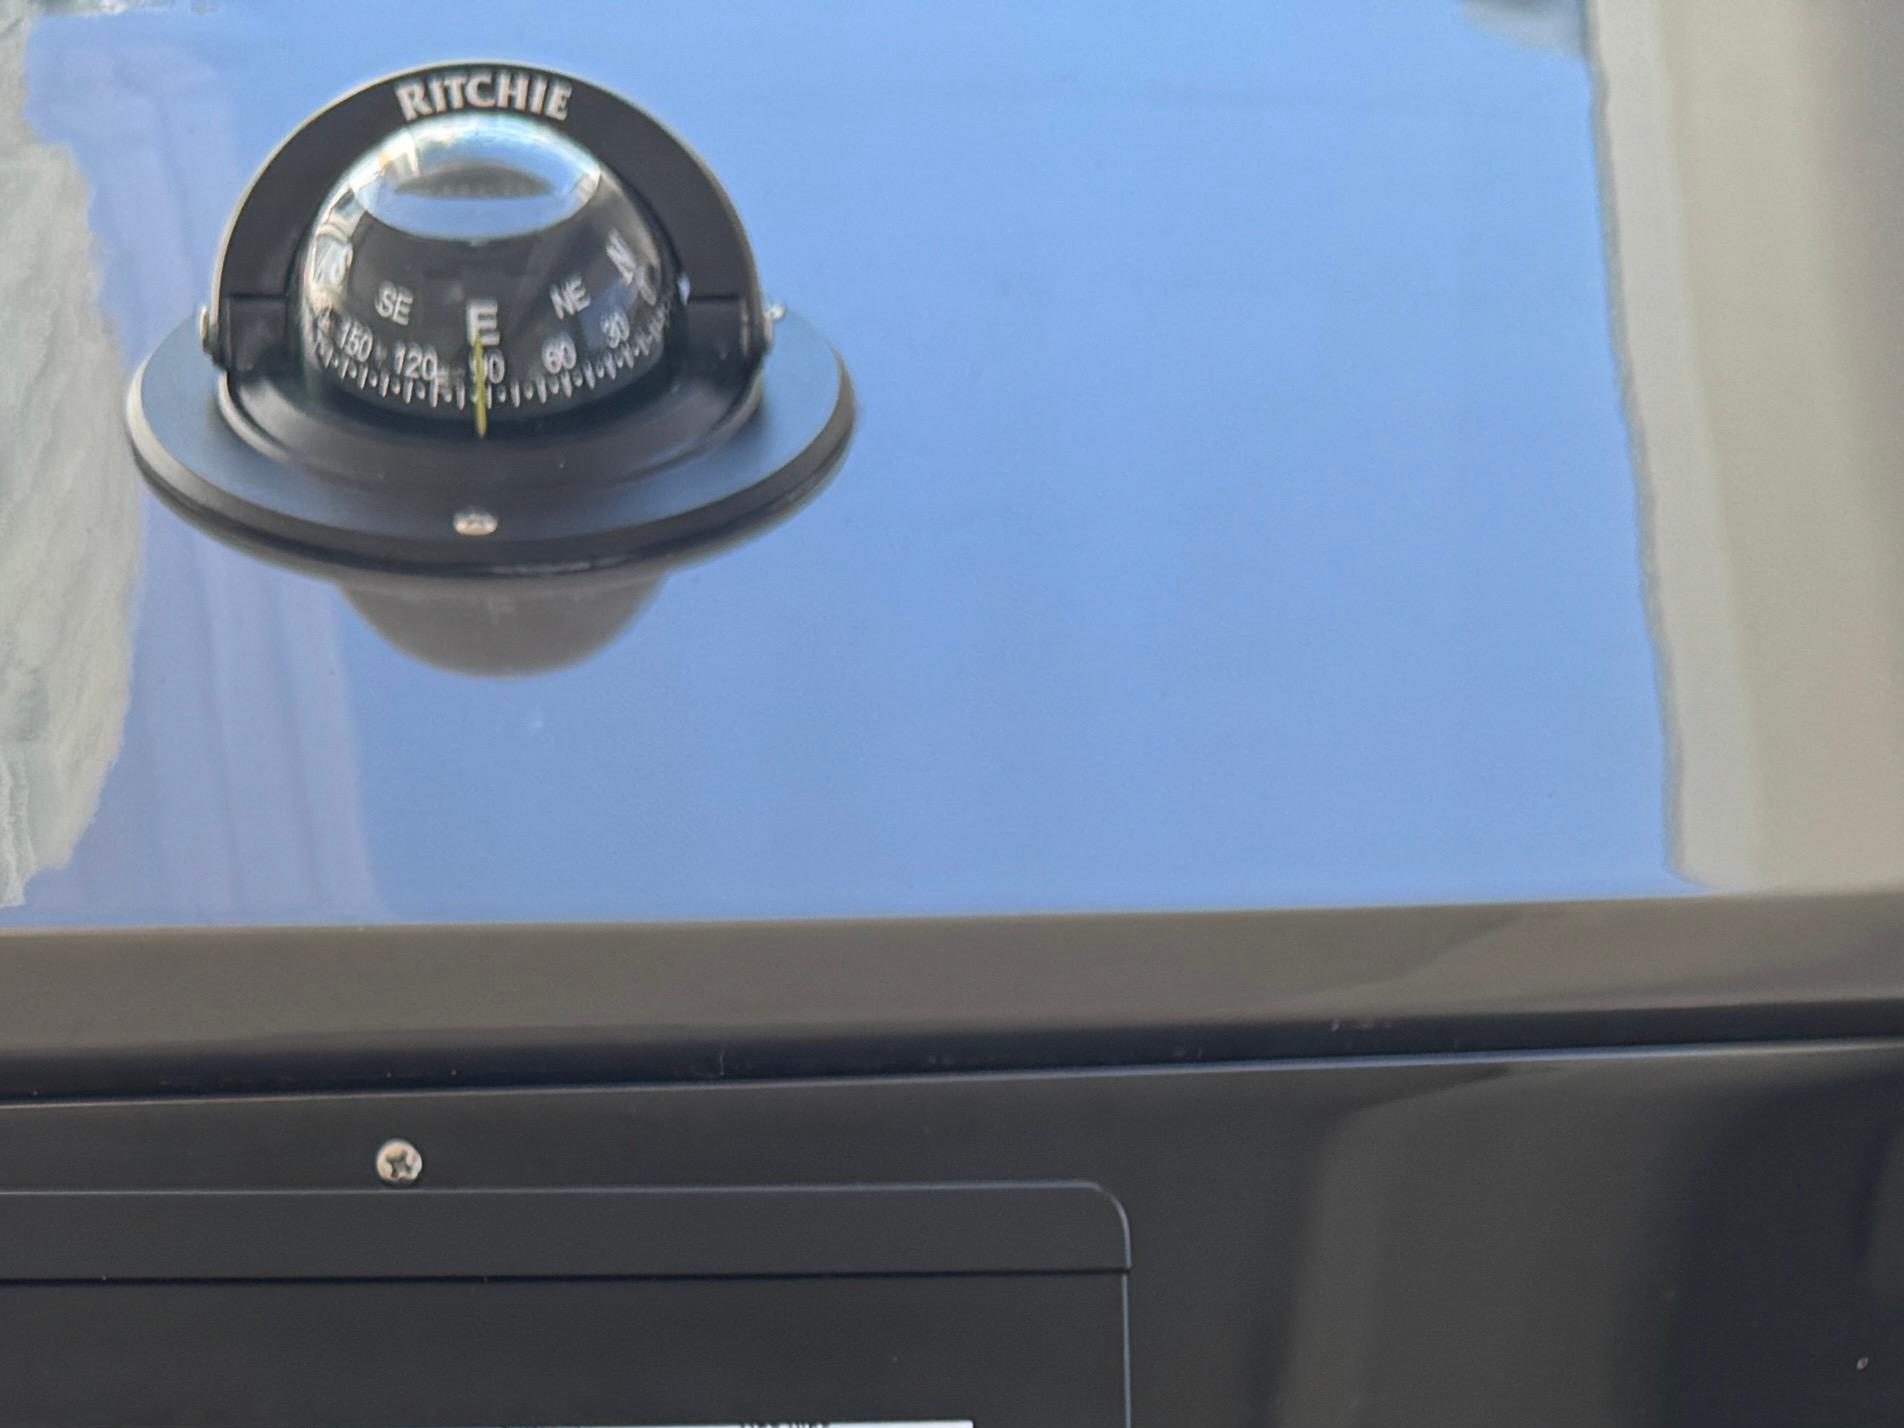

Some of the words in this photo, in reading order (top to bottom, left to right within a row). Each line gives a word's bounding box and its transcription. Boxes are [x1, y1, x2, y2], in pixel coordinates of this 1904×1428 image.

[397, 71, 573, 122] RITCHIE
[374, 281, 414, 326] SE
[549, 273, 592, 320] NE
[467, 303, 500, 347] E
[395, 344, 439, 382] 120
[542, 333, 578, 374] 60
